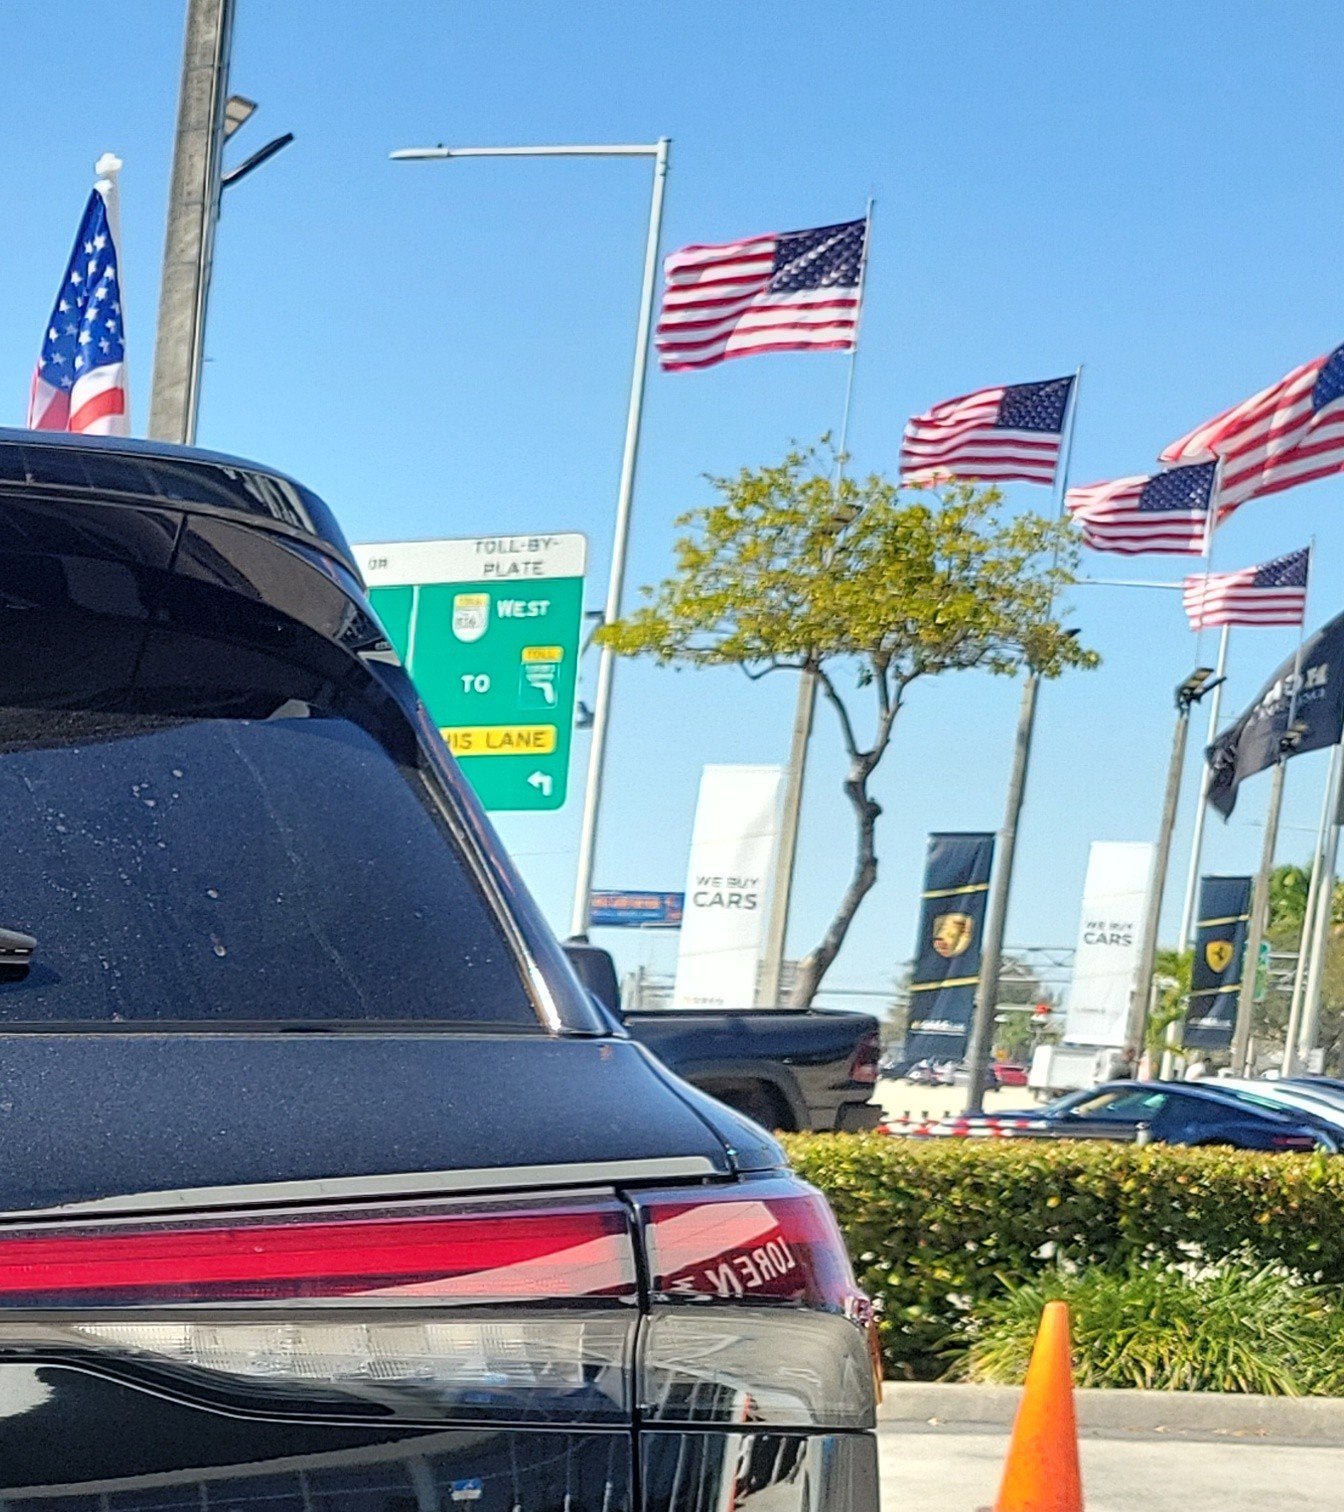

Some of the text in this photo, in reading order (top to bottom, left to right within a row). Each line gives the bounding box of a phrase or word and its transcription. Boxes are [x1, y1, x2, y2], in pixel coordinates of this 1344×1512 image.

[483, 560, 545, 577] PLATE
[497, 599, 551, 618] WEST
[461, 674, 491, 693] TO
[485, 731, 547, 749] LANE
[696, 876, 759, 889] WE BUY
[693, 892, 758, 911] CARS
[1084, 932, 1133, 947] CARS
